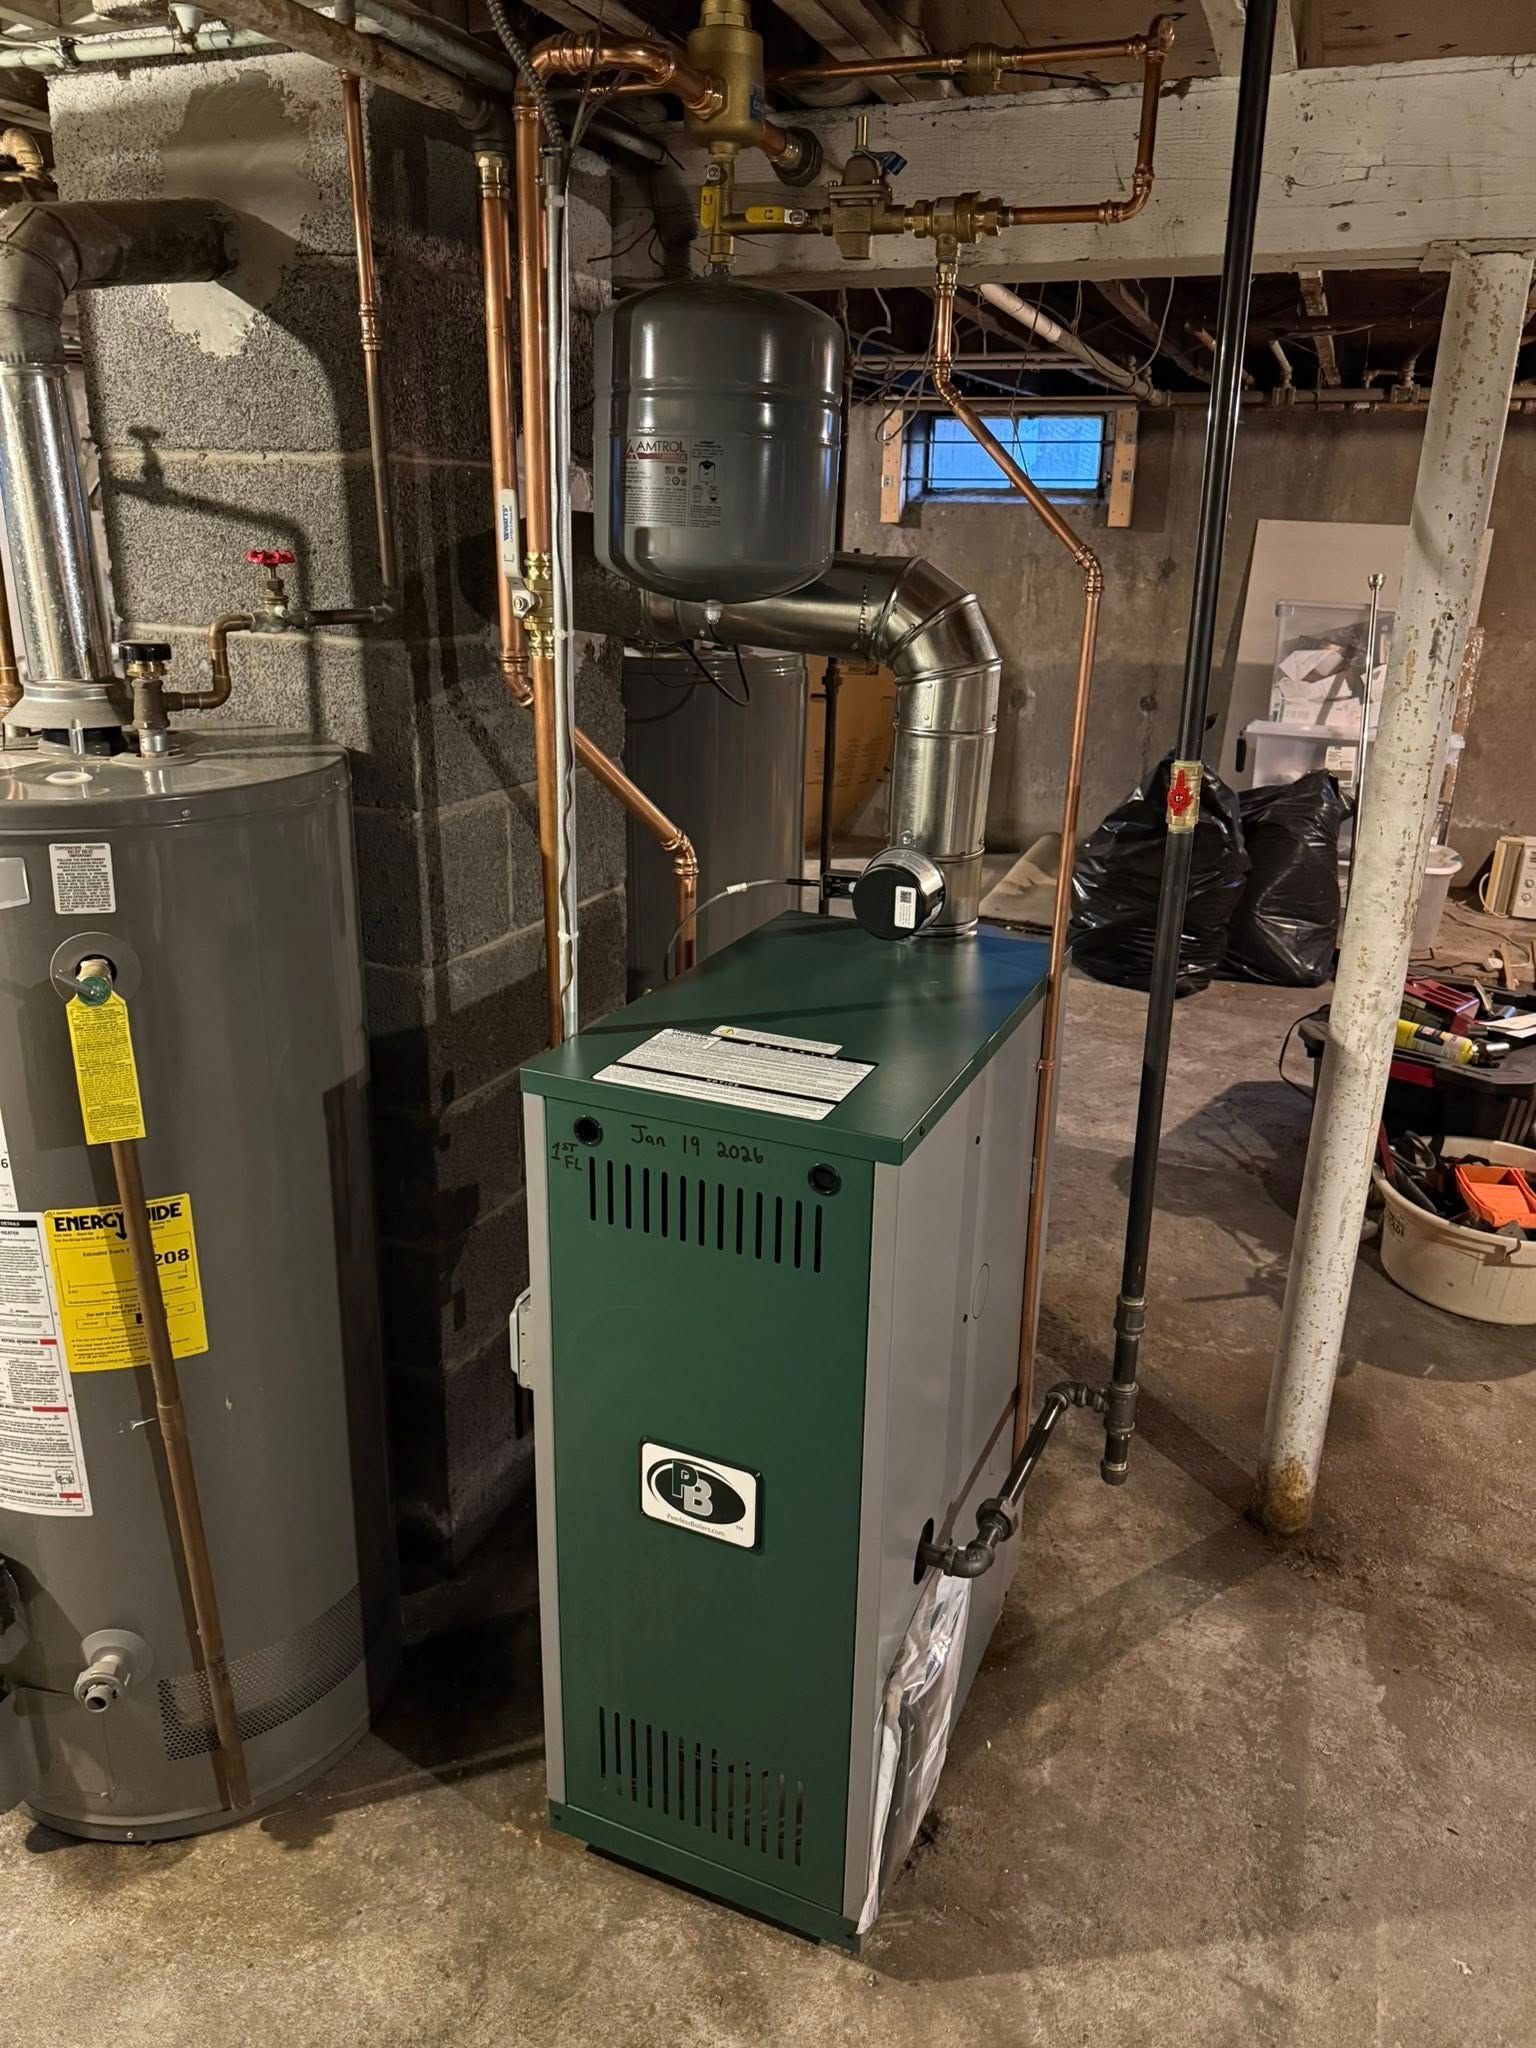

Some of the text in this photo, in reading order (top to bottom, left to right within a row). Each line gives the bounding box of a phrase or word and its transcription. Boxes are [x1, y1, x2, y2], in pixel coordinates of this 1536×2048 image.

[637, 441, 687, 453] AMTROL
[630, 1124, 764, 1164] Jan 19 2026
[564, 1155, 583, 1171] FL
[666, 1513, 726, 1537] PeerlessBoilers.com
